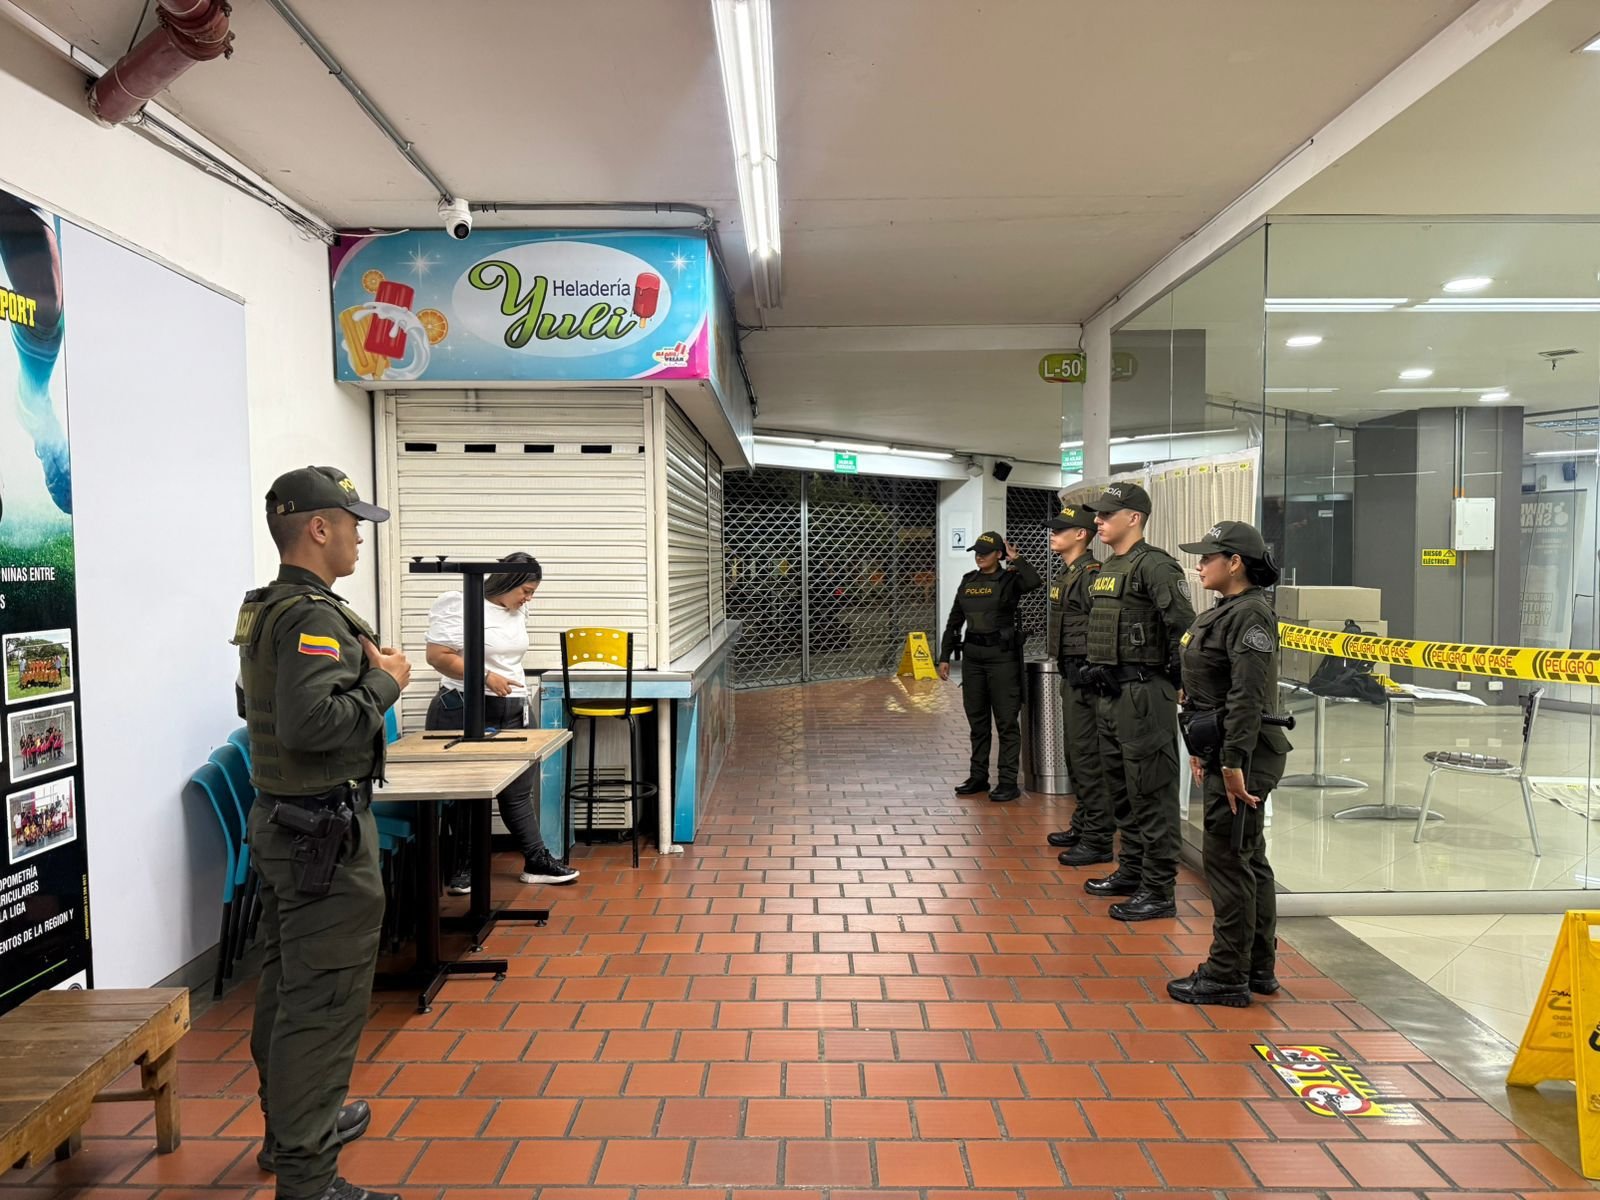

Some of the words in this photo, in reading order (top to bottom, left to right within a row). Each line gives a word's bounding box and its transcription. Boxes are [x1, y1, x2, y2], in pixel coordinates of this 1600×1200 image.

[553, 277, 631, 297] Heladería
[467, 259, 637, 349] Yuli
[1044, 359, 1081, 377] L-50
[1, 564, 27, 582] NIÑAS
[30, 566, 55, 581] ENTRE
[1286, 632, 1307, 643] PELIGRO
[1310, 635, 1317, 645] NO
[1318, 637, 1333, 649] PASE
[1349, 641, 1376, 654] PELIGRO
[1380, 645, 1389, 656] NO
[1391, 647, 1410, 658] PASE
[1432, 650, 1468, 665] PELIGRO
[1472, 653, 1486, 666] NO
[1488, 655, 1513, 669] PASE
[1545, 658, 1594, 675] PELIGRO
[9, 901, 26, 919] LIGA
[23, 928, 33, 943] DE
[34, 923, 43, 938] LA
[44, 910, 68, 932] REGION
[68, 907, 74, 920] Y
